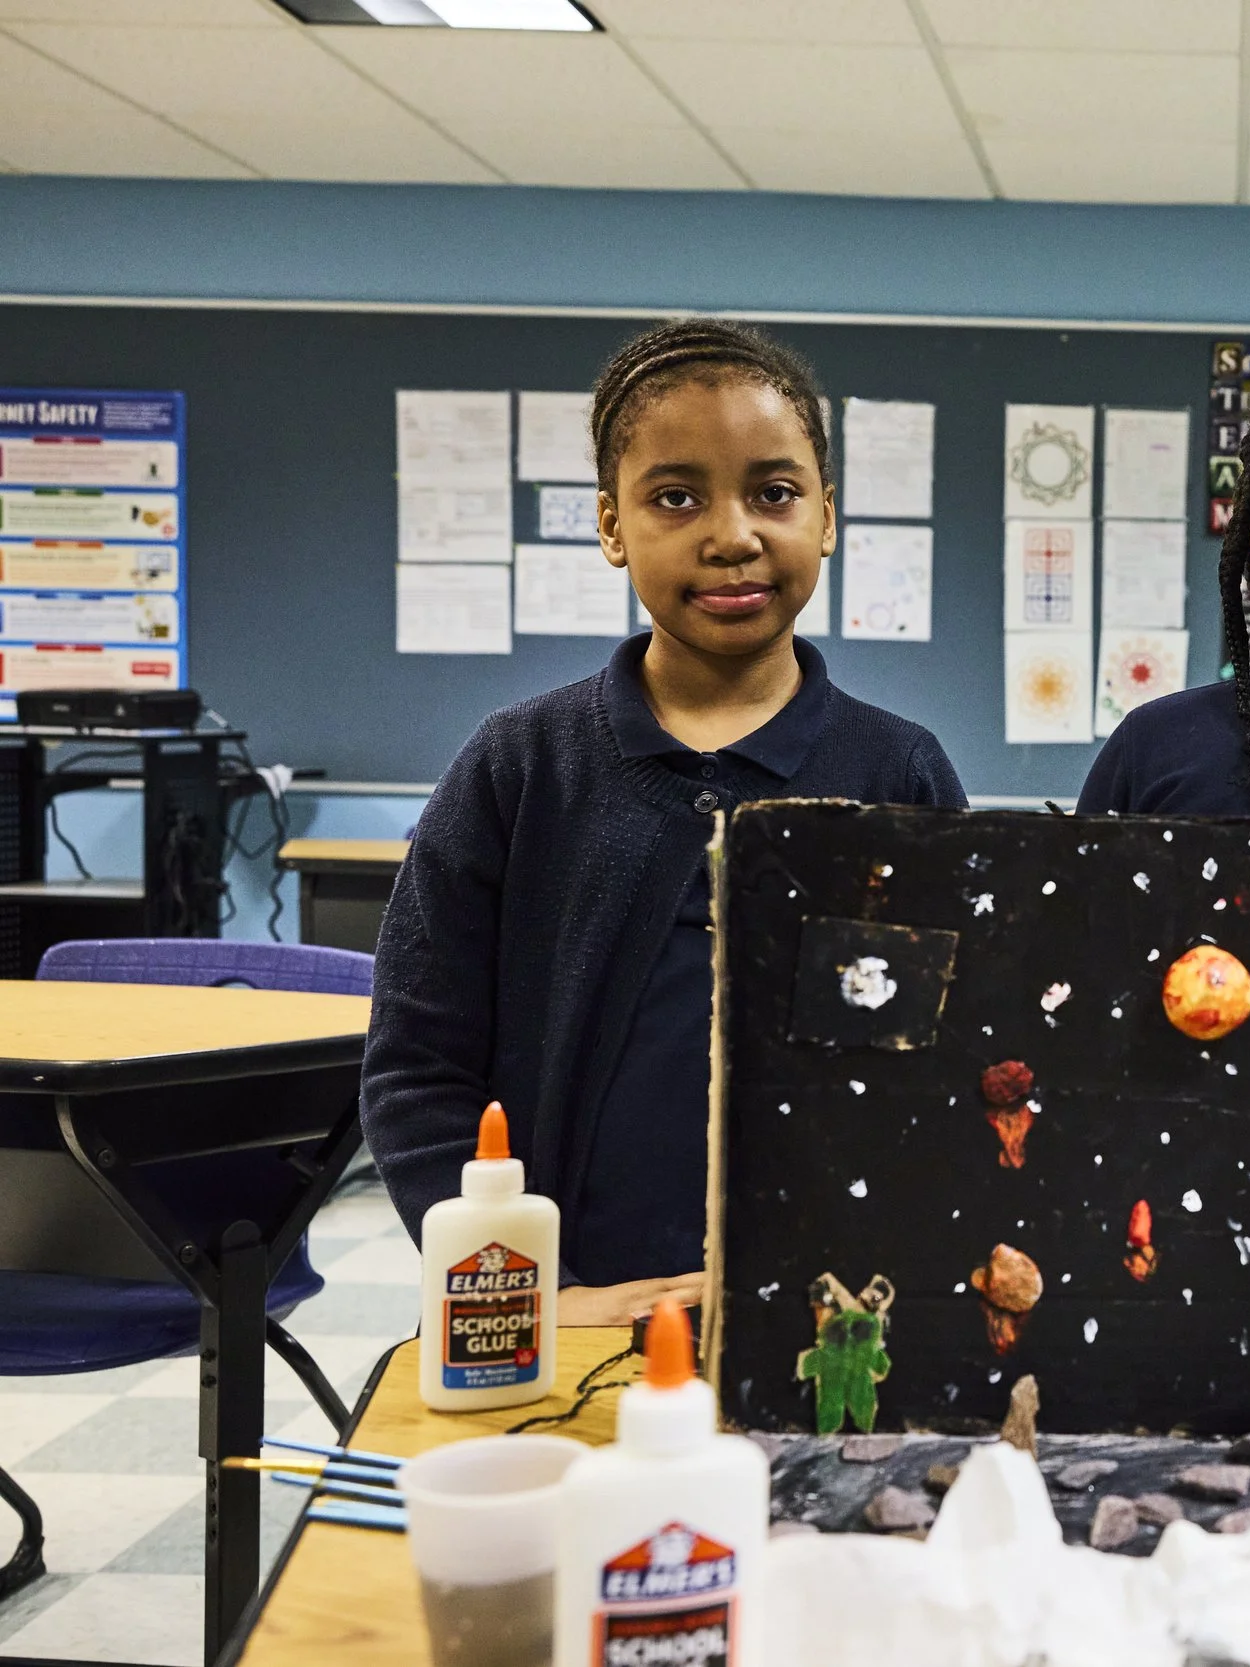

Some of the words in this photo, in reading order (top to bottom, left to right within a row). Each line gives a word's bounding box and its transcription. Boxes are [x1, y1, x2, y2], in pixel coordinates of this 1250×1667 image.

[39, 401, 98, 425] SAFETY
[450, 1269, 535, 1292] ELMER'S
[452, 1314, 532, 1335] SCHOOL
[466, 1333, 518, 1354] GLUE
